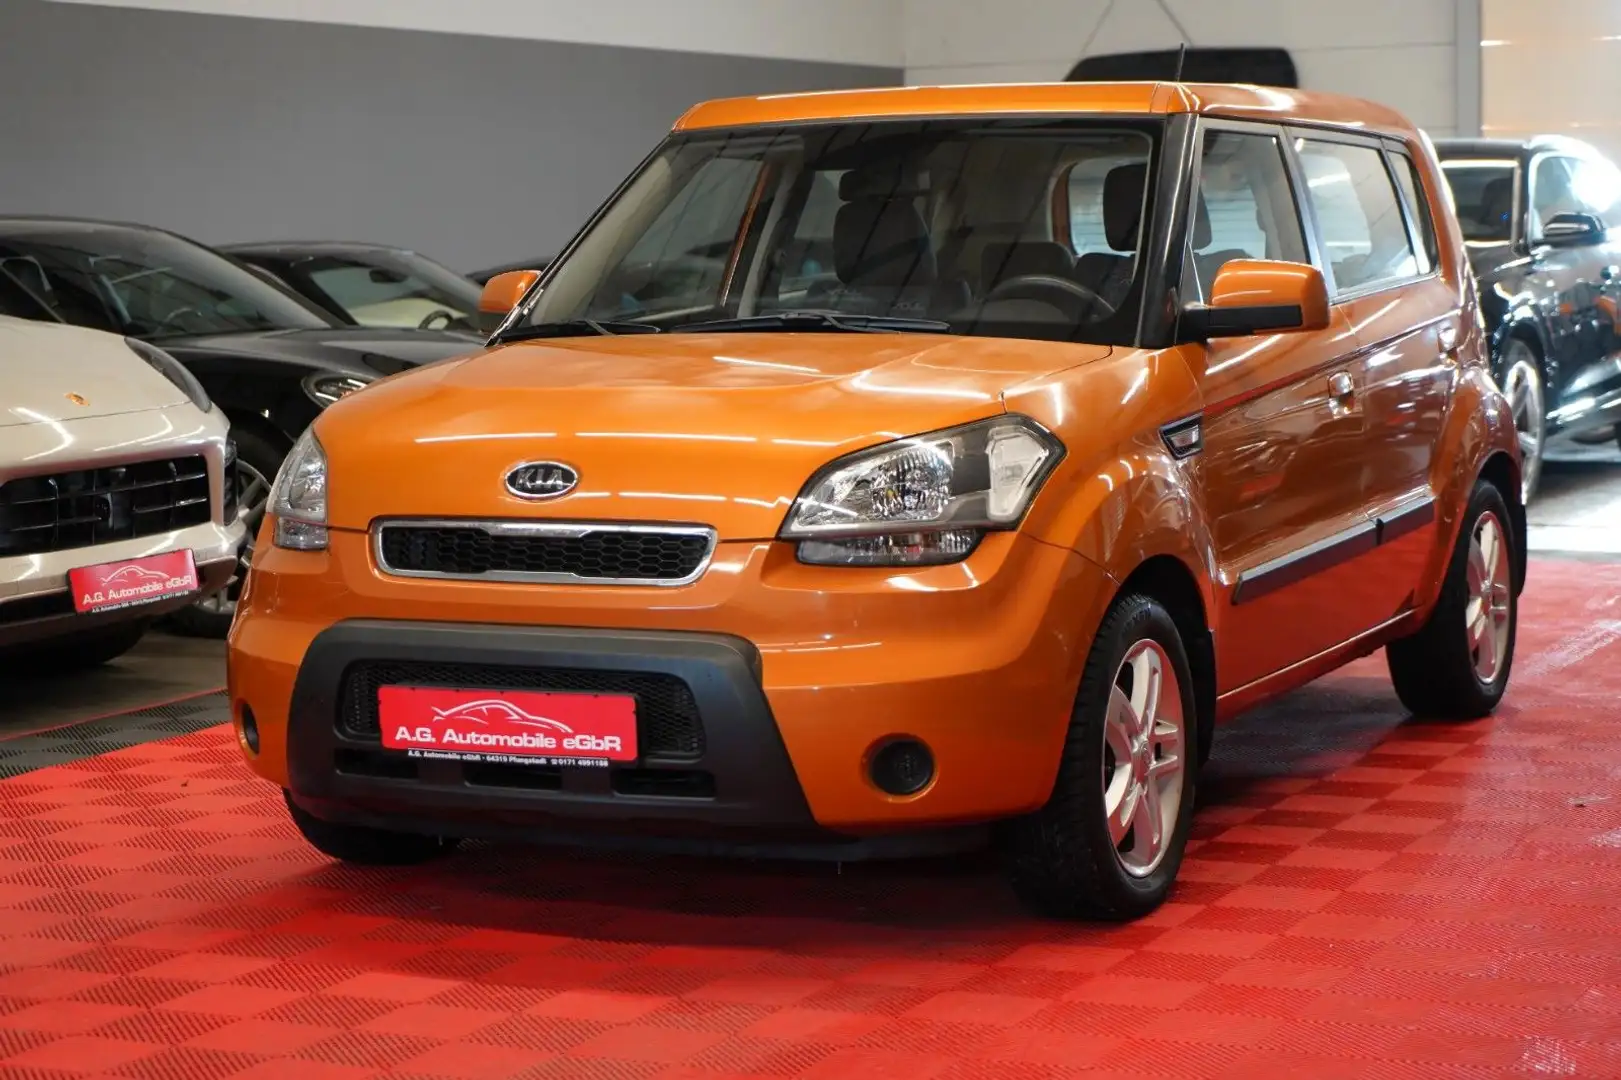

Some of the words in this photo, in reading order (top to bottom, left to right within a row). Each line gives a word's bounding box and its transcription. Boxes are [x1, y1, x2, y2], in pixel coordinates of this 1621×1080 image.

[515, 468, 563, 489] KIA
[83, 592, 104, 605] A.G.
[108, 582, 163, 600] Automobile
[166, 576, 192, 588] eGbR
[395, 726, 436, 743] A.G.
[442, 728, 556, 749] Automobile
[563, 734, 621, 752] eGbR
[423, 751, 460, 760] Automobile
[462, 753, 481, 761] eGbR
